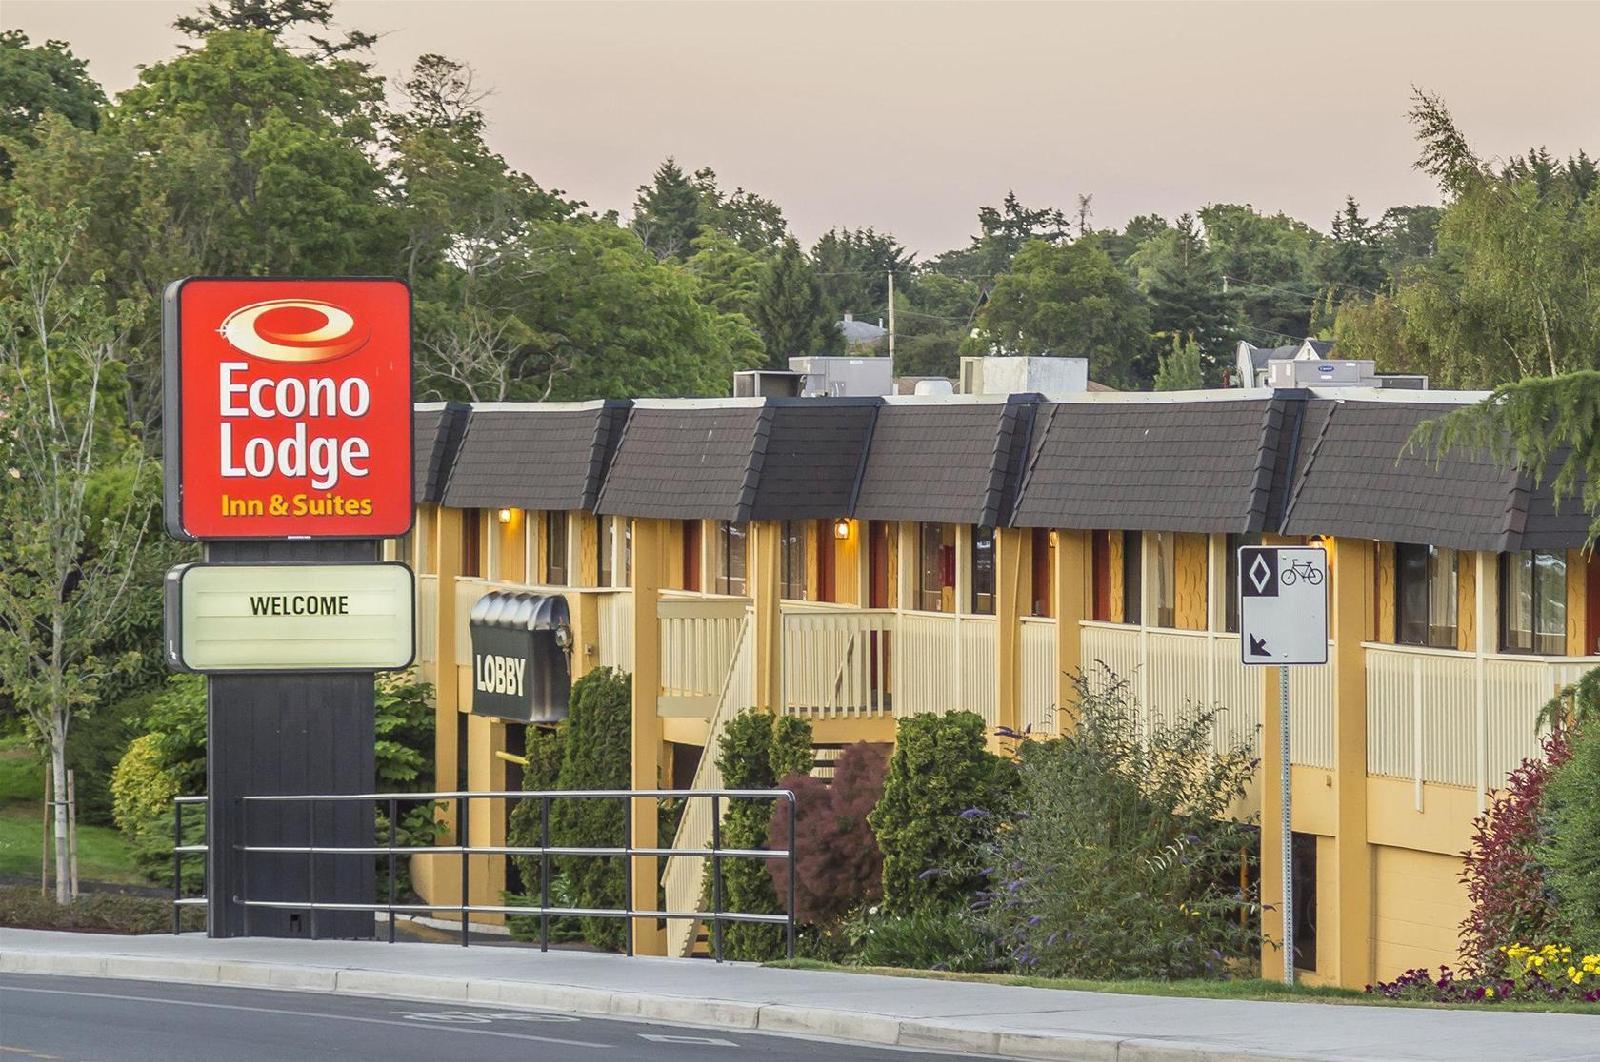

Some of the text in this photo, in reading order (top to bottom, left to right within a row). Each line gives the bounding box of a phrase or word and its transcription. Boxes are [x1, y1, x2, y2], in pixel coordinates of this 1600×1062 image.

[219, 362, 370, 418] Econo
[219, 422, 370, 490] Lodge
[222, 493, 373, 517] Inn & Suites
[249, 596, 349, 616] WELCOME
[476, 654, 526, 697] LOBBY
